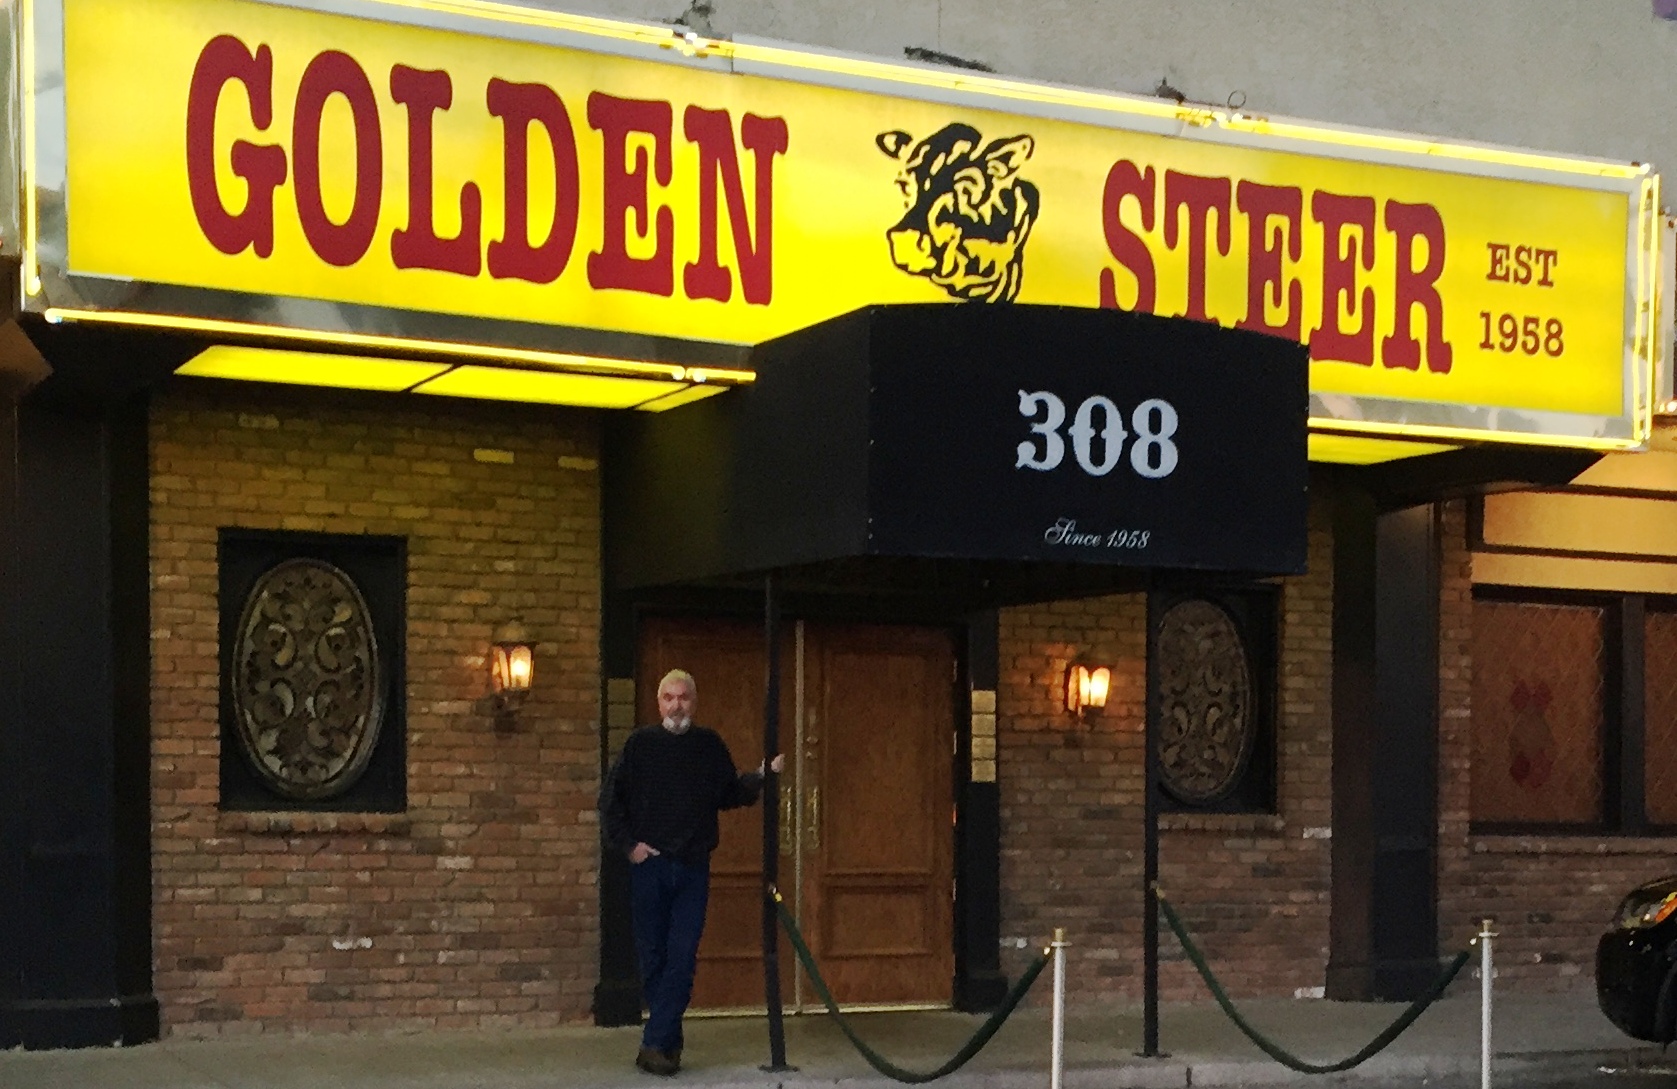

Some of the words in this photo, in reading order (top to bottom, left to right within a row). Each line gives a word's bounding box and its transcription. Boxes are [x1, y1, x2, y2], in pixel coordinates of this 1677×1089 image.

[186, 34, 789, 306] GOLDEN
[1099, 158, 1454, 376] STEER
[1485, 241, 1558, 288] EST
[1478, 310, 1566, 358] 1958
[1015, 388, 1180, 479] 308
[1044, 517, 1101, 548] Since
[1106, 528, 1151, 550] 1958
